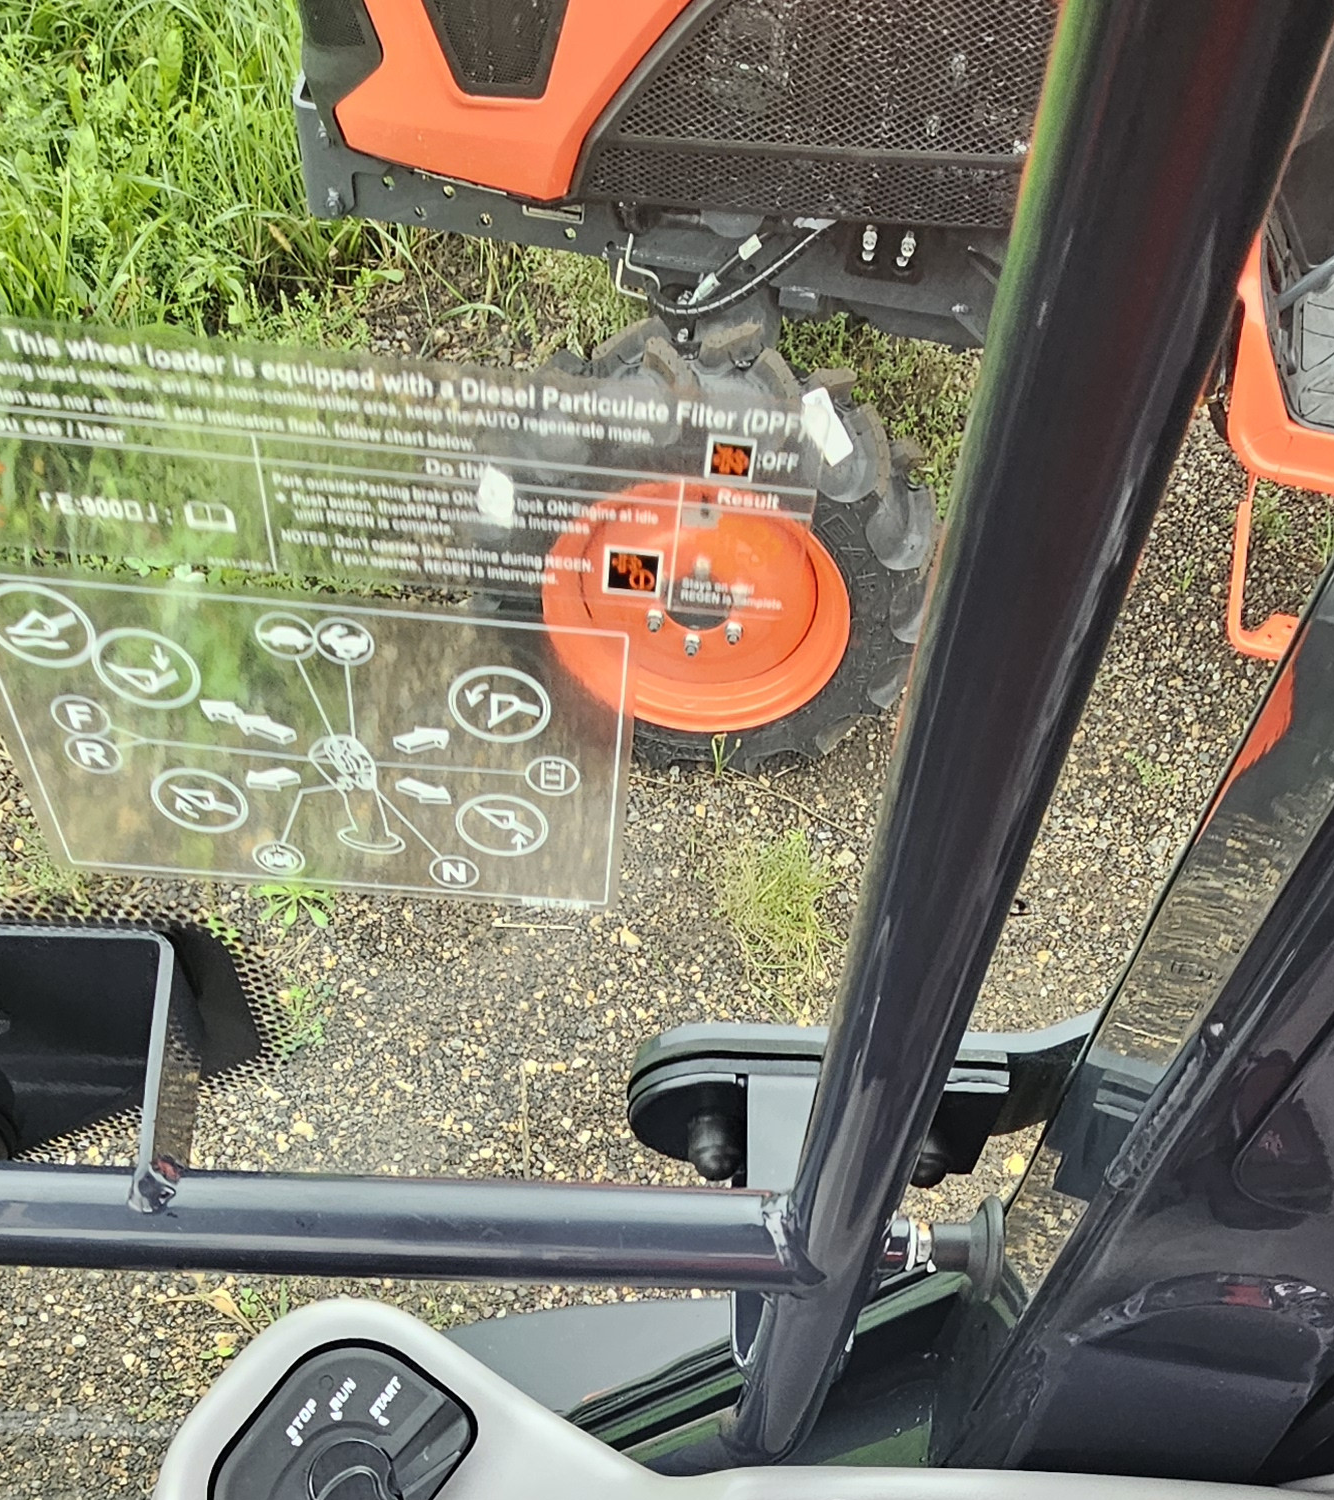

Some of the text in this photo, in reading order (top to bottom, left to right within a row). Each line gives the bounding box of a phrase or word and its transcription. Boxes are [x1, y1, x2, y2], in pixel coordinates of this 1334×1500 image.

[1, 327, 61, 357] This
[63, 334, 141, 366] wheel
[145, 344, 227, 375] loader
[232, 353, 255, 379] is
[260, 357, 374, 396] equipped
[382, 370, 432, 398] with
[440, 381, 453, 399] a
[462, 379, 533, 409] Diesel
[543, 389, 669, 424] Particulate
[676, 404, 737, 432] Filter
[34, 363, 78, 382] used
[160, 377, 191, 394] and
[406, 404, 442, 425] keep
[447, 407, 474, 425] the
[476, 409, 518, 430] AUTO
[524, 415, 604, 442] regenerate
[22, 420, 63, 435] see
[76, 422, 126, 443] hear
[26, 392, 60, 407] was
[61, 393, 92, 411] not
[172, 405, 203, 423] and
[206, 409, 284, 431] indicators
[334, 421, 380, 441] follow
[384, 427, 423, 446] chart
[425, 459, 452, 476] Do
[272, 472, 302, 487] Park
[413, 488, 448, 503] brake
[518, 499, 542, 512] lock
[619, 509, 631, 521] at
[636, 511, 658, 524] idle
[717, 488, 779, 509] Result
[292, 492, 325, 506] Push
[529, 517, 589, 533] increases
[294, 508, 324, 522] until
[327, 510, 373, 527] REGEN
[377, 517, 388, 528] is
[344, 554, 366, 566] you
[424, 560, 469, 576] REGEN
[474, 565, 483, 577] is
[371, 540, 418, 556] operate
[422, 544, 441, 556] the
[446, 546, 497, 562] machine
[502, 551, 541, 567] during
[680, 590, 719, 603] REGEN
[65, 703, 92, 730] F
[76, 741, 111, 767] R
[441, 862, 468, 883] N
[329, 1377, 357, 1411] RUN
[369, 1375, 401, 1419] START
[286, 1398, 317, 1440] STOP
